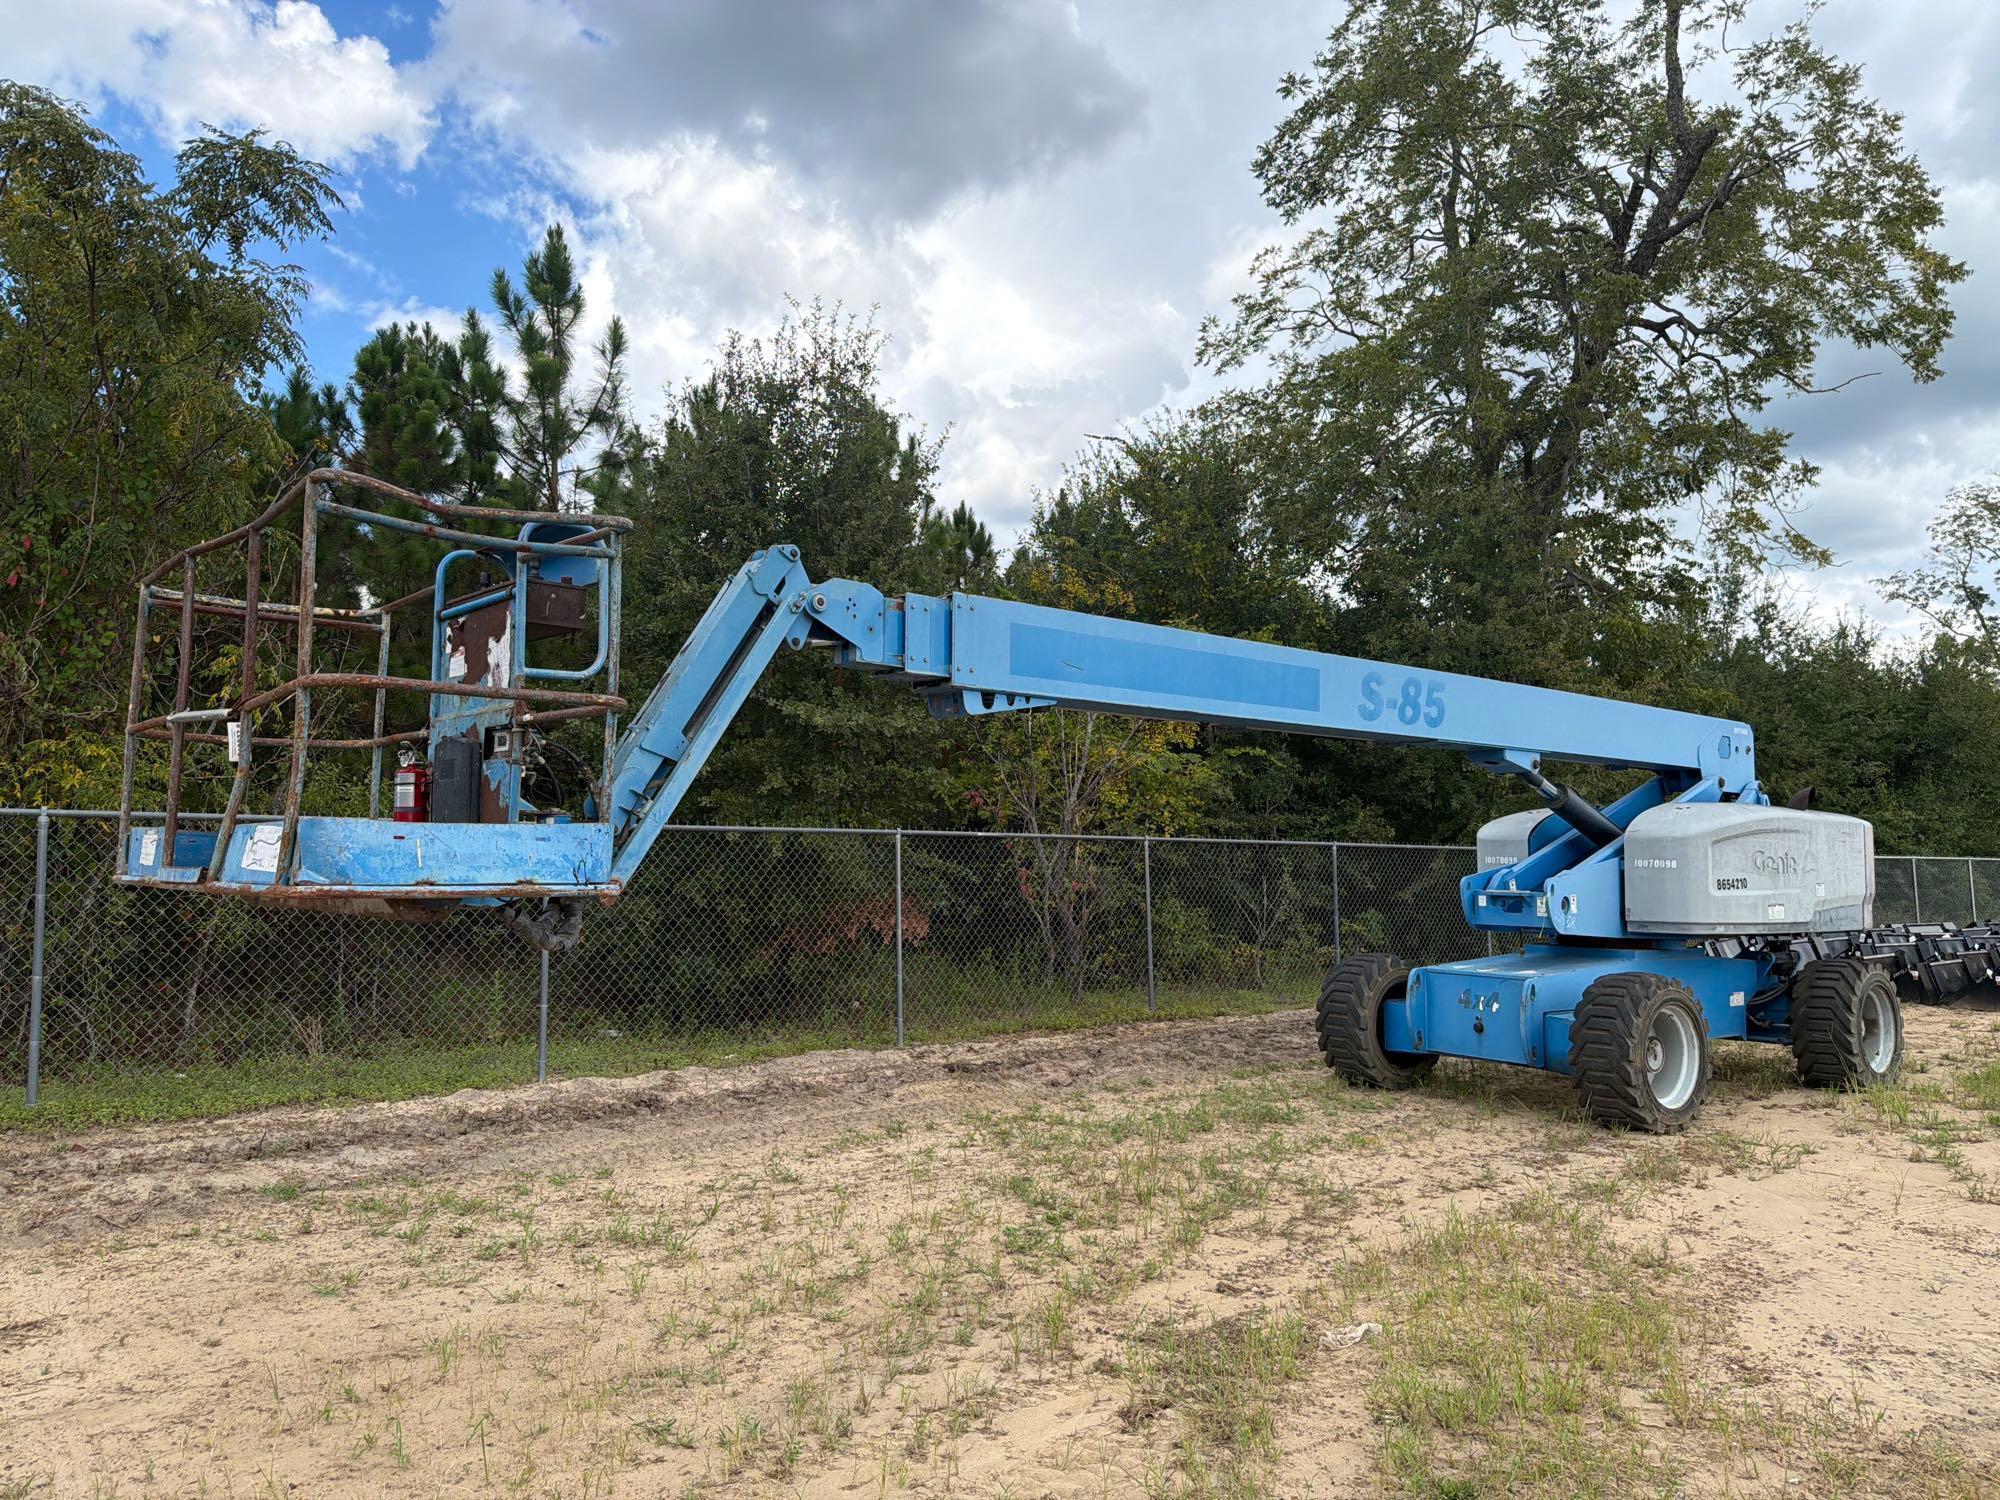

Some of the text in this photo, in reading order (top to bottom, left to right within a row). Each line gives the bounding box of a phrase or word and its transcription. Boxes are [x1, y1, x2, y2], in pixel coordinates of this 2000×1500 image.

[1358, 671, 1446, 728] S-85
[1634, 859, 1677, 868] 10070098
[1716, 877, 1748, 891] 8654210
